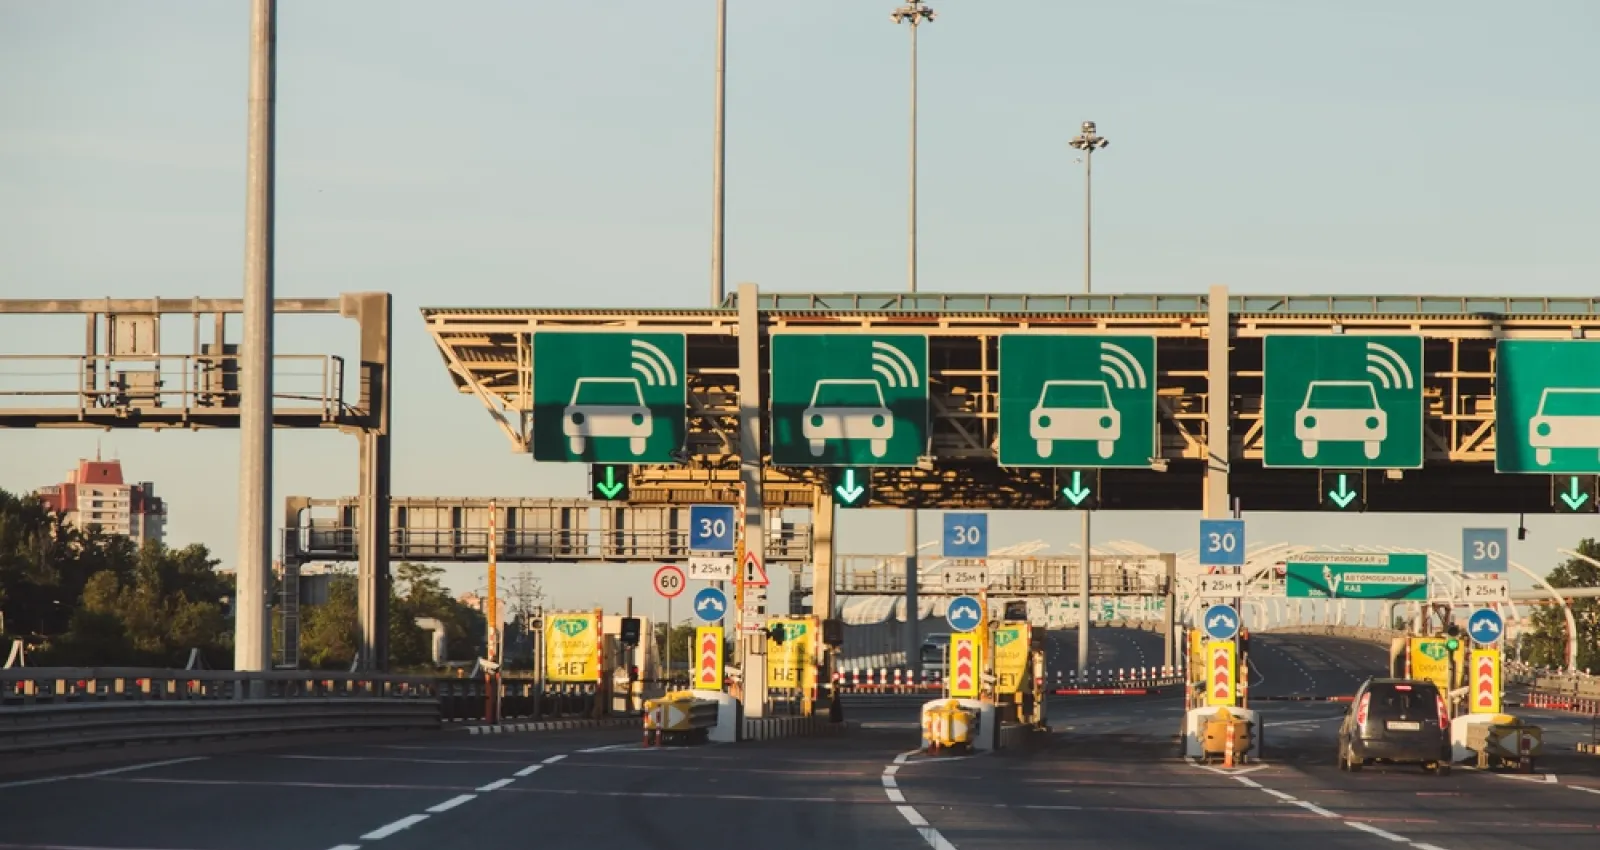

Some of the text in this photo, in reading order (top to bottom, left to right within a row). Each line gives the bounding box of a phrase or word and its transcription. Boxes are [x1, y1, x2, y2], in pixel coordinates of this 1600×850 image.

[699, 518, 726, 538] 30
[952, 525, 980, 545] 30
[1208, 532, 1236, 553] 30
[1473, 541, 1500, 561] 30
[660, 575, 678, 588] 60
[557, 661, 588, 675] НЕТ
[773, 667, 804, 681] НЕТ
